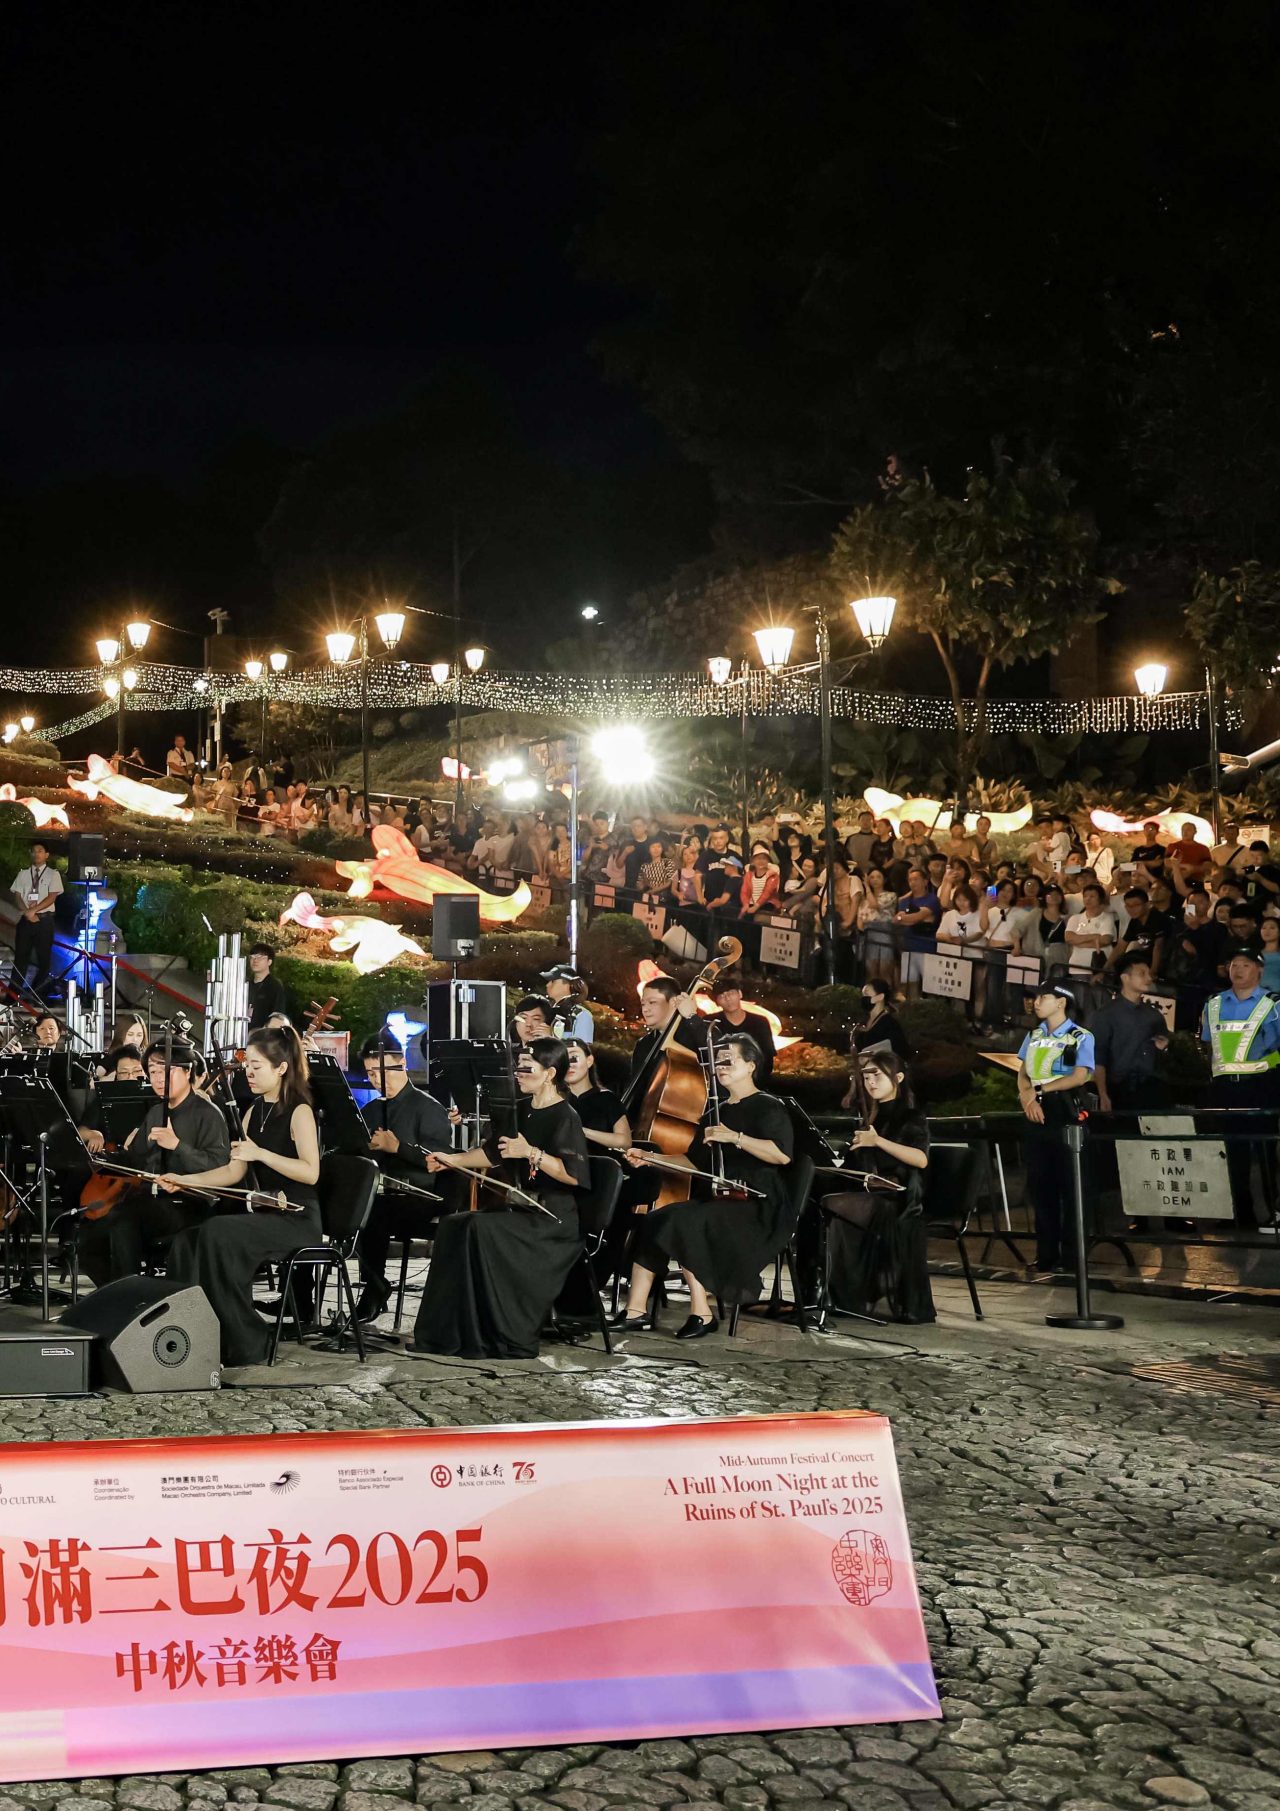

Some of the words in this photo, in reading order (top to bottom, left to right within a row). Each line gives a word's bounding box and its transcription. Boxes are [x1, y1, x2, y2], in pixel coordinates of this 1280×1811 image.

[1162, 1167, 1185, 1175] IAM
[1163, 1196, 1191, 1206] DEM
[719, 1455, 788, 1467] Mid-Autumn
[790, 1453, 830, 1465] Festival
[831, 1452, 875, 1463] Concert
[664, 1478, 679, 1496] A
[682, 1476, 716, 1495] Full
[721, 1475, 772, 1494] Moon
[776, 1472, 827, 1496] Night
[831, 1474, 848, 1488] at
[852, 1471, 879, 1488] the
[9, 1496, 56, 1505] CULTURAL
[684, 1503, 736, 1521] Ruins
[740, 1501, 757, 1519] of
[762, 1501, 786, 1518] St.
[790, 1498, 838, 1517] Paul's
[843, 1496, 883, 1515] 2025
[114, 1632, 343, 1692] 中秋音樂會
